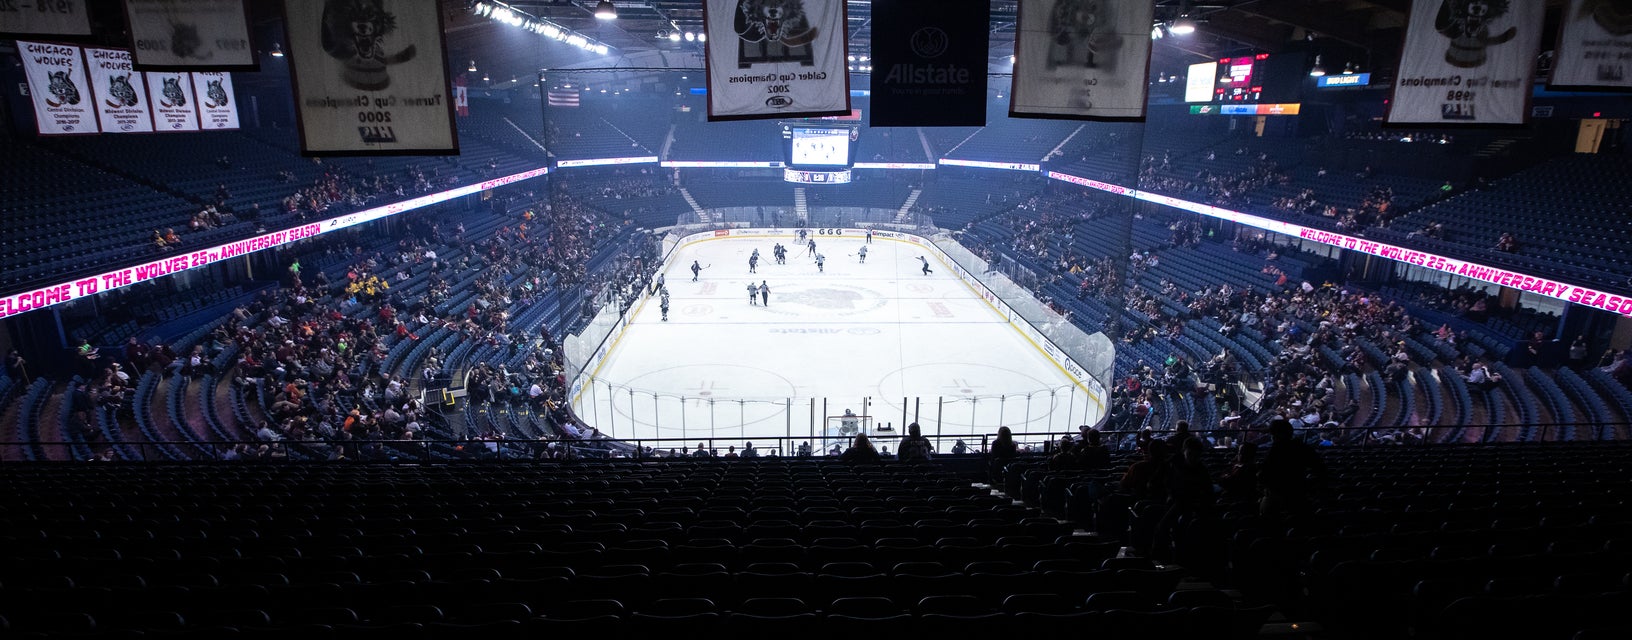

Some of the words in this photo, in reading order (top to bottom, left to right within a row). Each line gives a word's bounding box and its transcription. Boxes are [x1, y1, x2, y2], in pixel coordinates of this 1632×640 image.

[27, 44, 73, 56] CHICAGO
[93, 50, 132, 61] CHICAGO
[33, 56, 73, 67] WOLVES
[100, 61, 132, 70] WOLVES
[884, 63, 969, 84] Allstate
[76, 278, 97, 296] TO
[103, 270, 132, 289] THE
[136, 257, 188, 281] WOLVES
[221, 232, 287, 259] ANNIVERSARY
[289, 223, 321, 241] SEASON
[1300, 228, 1342, 246] WELCOME
[1345, 237, 1357, 250] TO
[1359, 240, 1379, 254] THE
[1381, 245, 1426, 265] WOLVES
[1458, 263, 1568, 298] ANNIVERSARY
